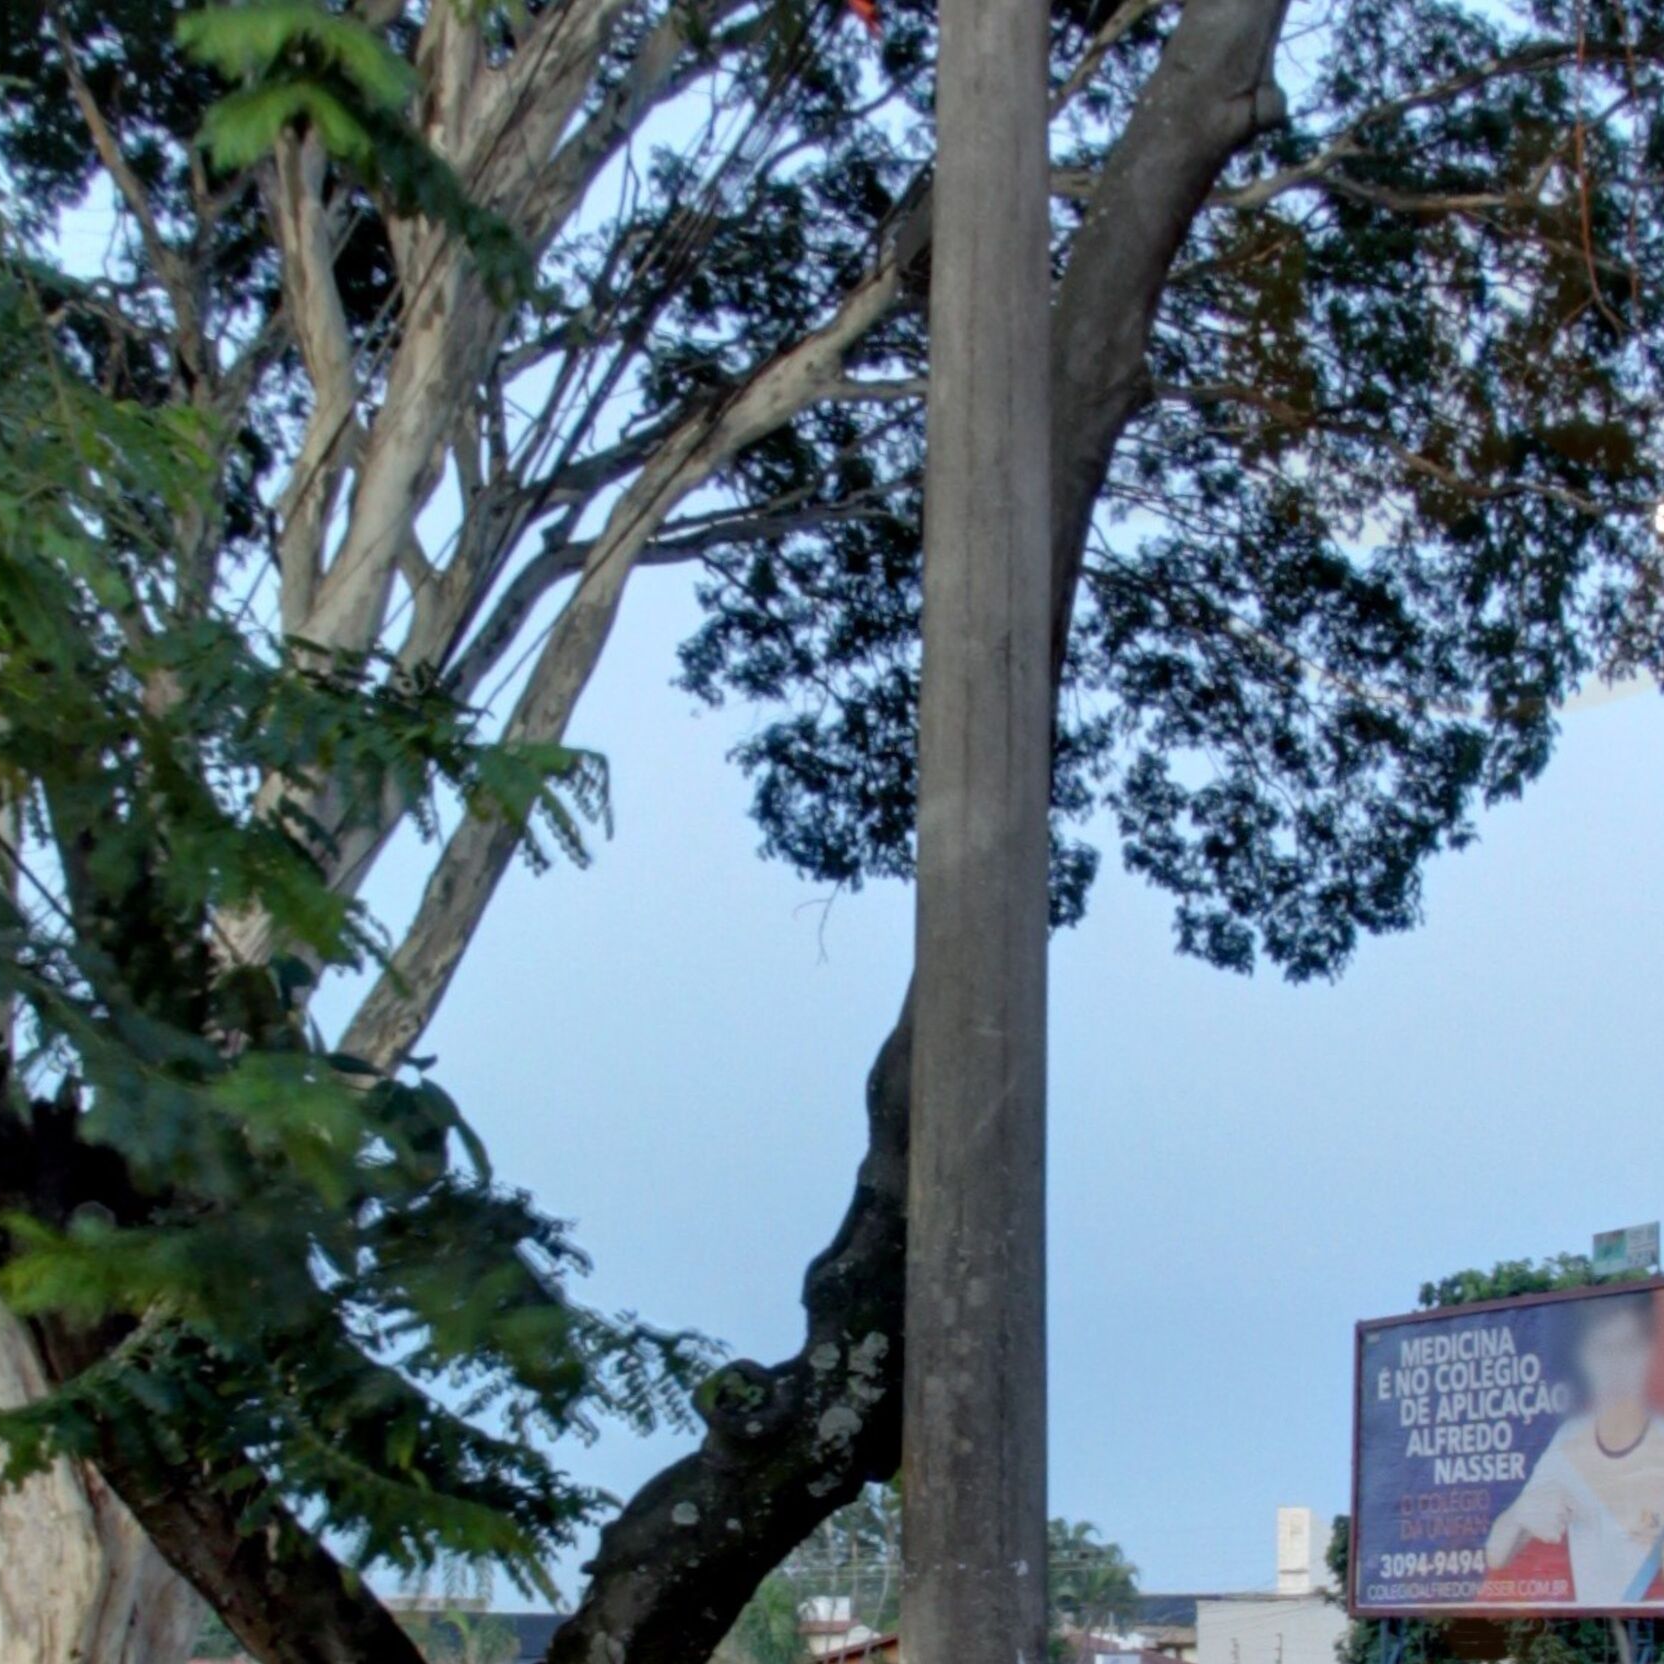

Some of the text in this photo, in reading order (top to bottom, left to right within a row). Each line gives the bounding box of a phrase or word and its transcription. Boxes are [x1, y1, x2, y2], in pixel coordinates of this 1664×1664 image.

[1400, 1326, 1516, 1367] MEDICINA
[1377, 1366, 1392, 1400] É
[1395, 1367, 1430, 1398] NO
[1400, 1379, 1572, 1427] DE APLICAÇÃO
[1405, 1420, 1513, 1458] ALFREDO
[1434, 1452, 1526, 1485] NASSER
[1379, 1550, 1486, 1579] 3094-9494
